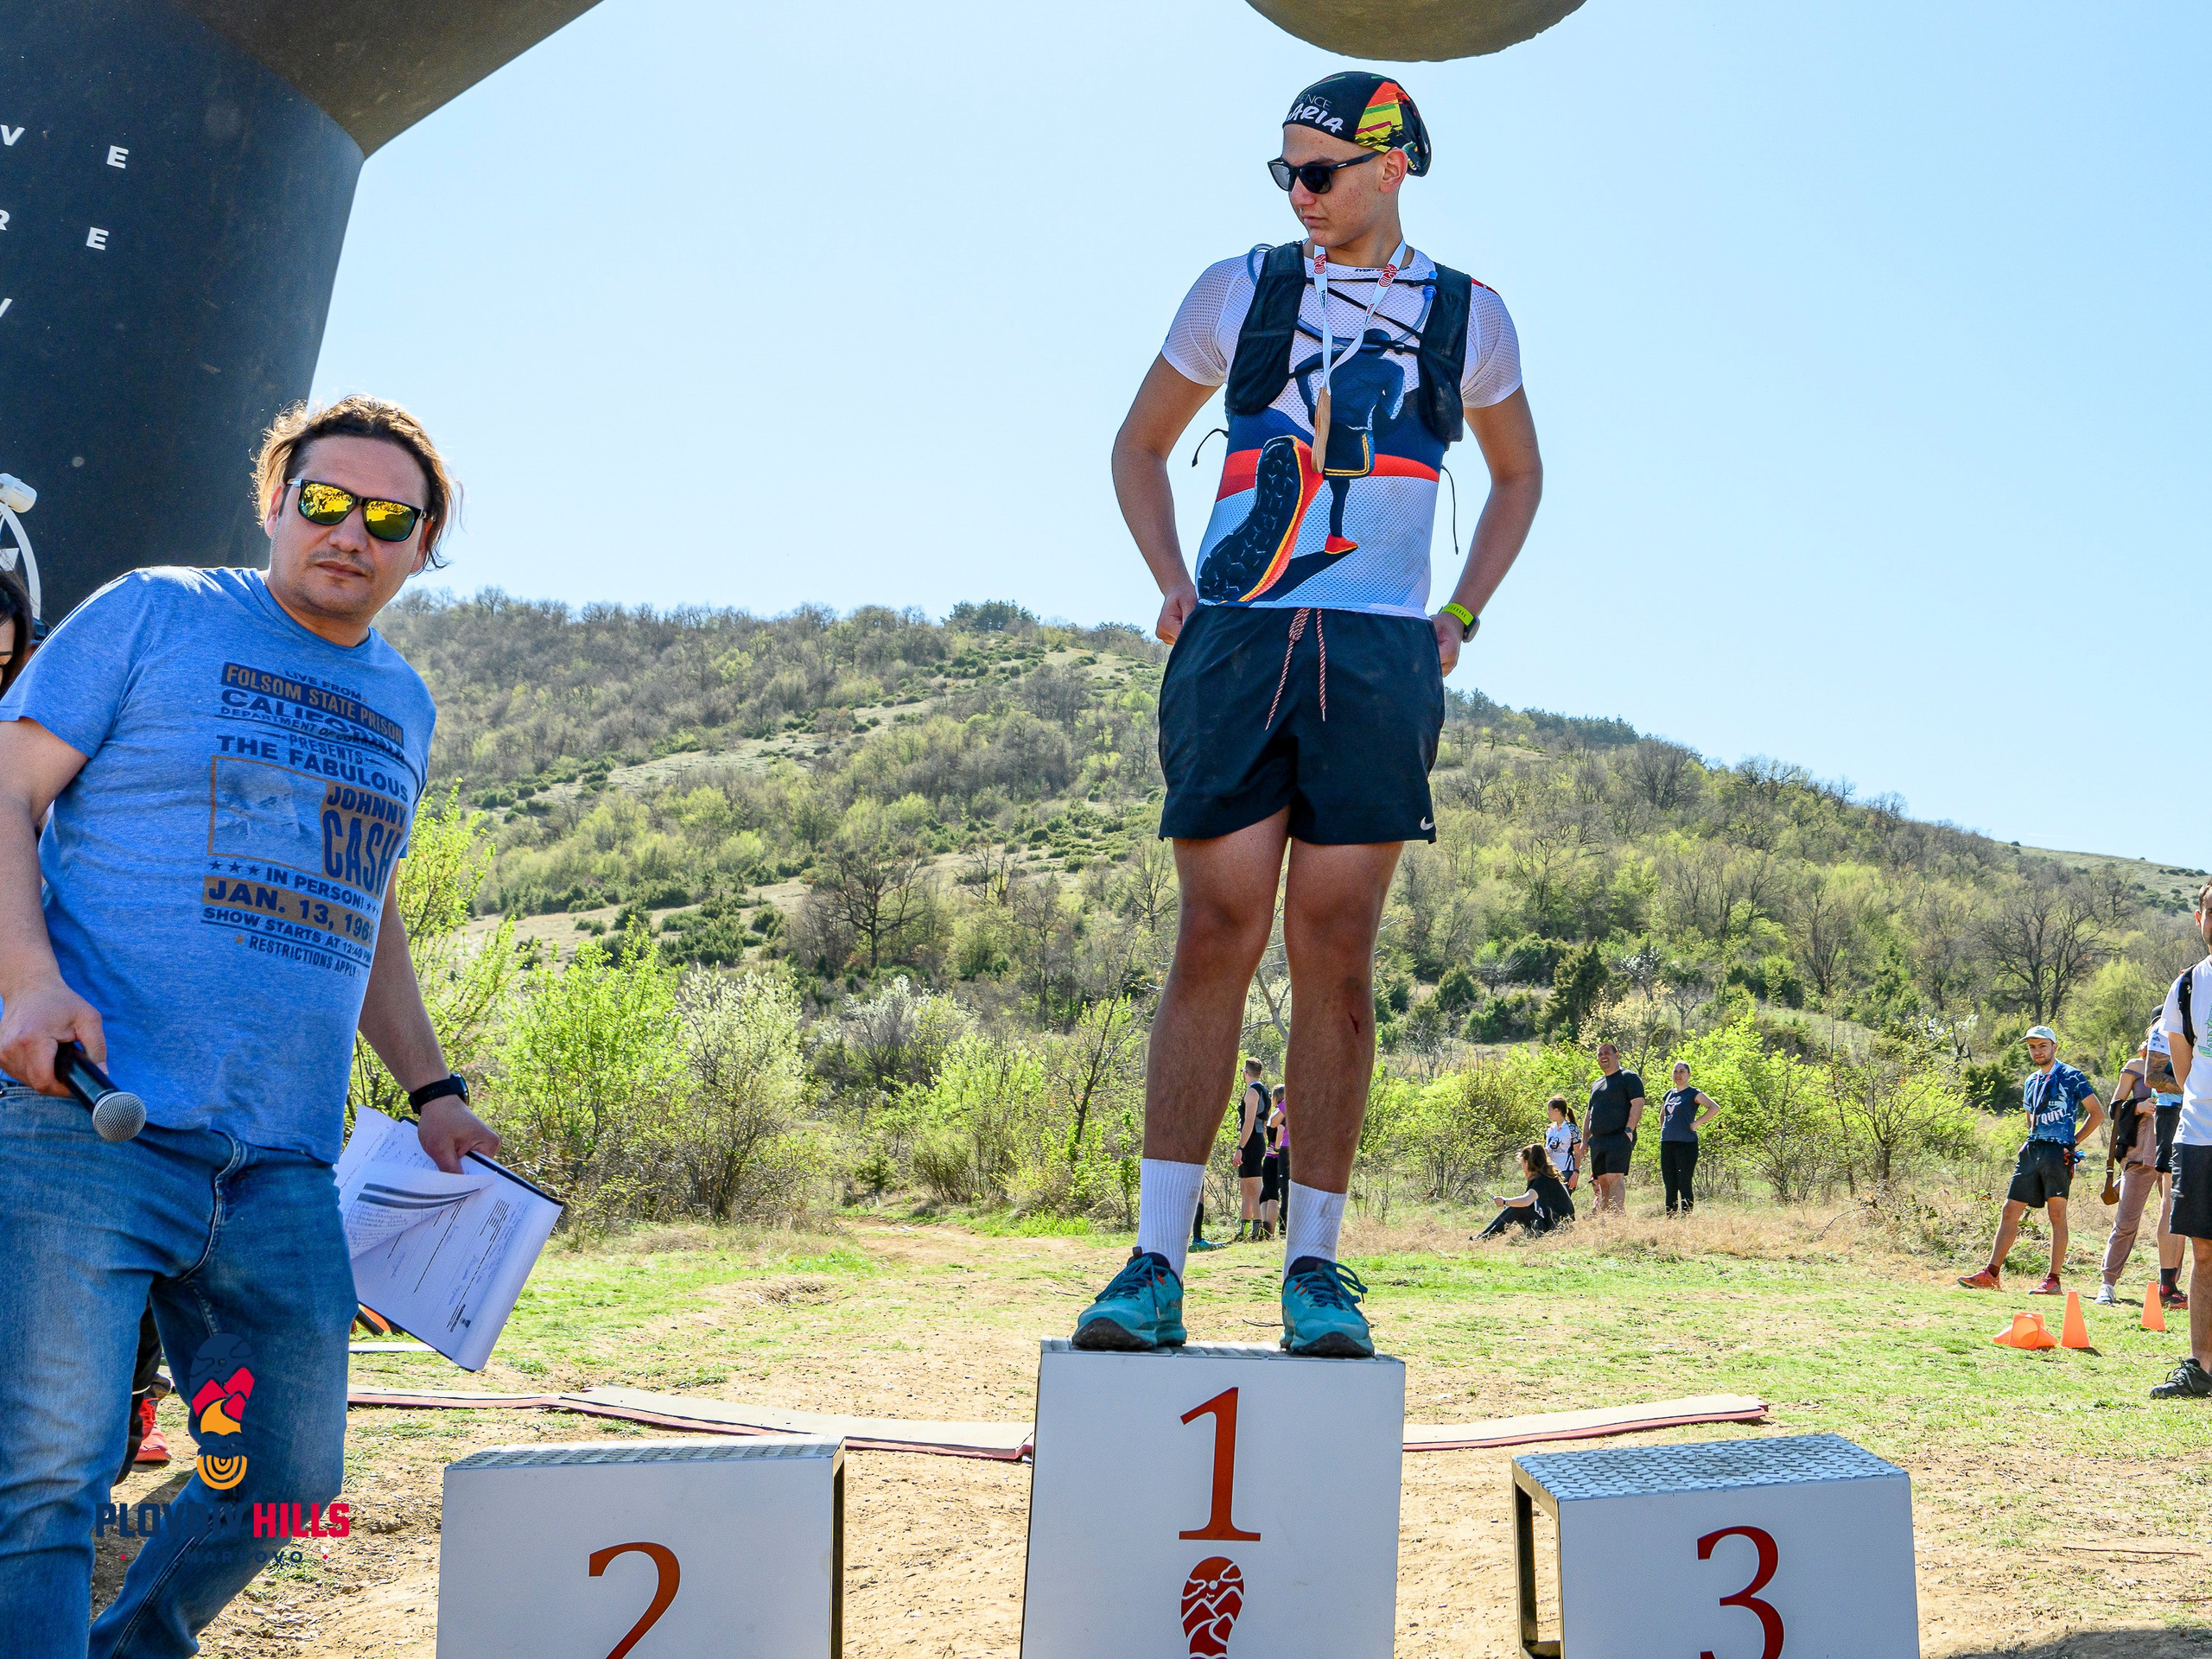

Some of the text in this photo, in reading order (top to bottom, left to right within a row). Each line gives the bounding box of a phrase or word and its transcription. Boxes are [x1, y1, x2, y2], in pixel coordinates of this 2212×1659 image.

[226, 664, 403, 745] FOLSOM STATE PRISON
[284, 671, 361, 701] LIVE FROM
[220, 706, 317, 734] DEPARTMENT
[217, 734, 408, 803] THE FABULOUS
[289, 734, 363, 765] PRESENTS
[327, 785, 407, 828] JOHNNY
[323, 810, 401, 896] CASH
[208, 880, 285, 912] JAN.
[300, 899, 334, 931] 13,
[266, 867, 364, 909] IN PERSON!
[203, 907, 260, 928] SHOW
[264, 916, 321, 943] STARTS
[325, 936, 340, 948] AT
[249, 936, 358, 977] RESTRICTIONS APPLY
[2041, 1109, 2064, 1126] QUIT
[1179, 1387, 1262, 1541] 1
[588, 1541, 681, 1659] 2
[1697, 1526, 1785, 1659] 3
